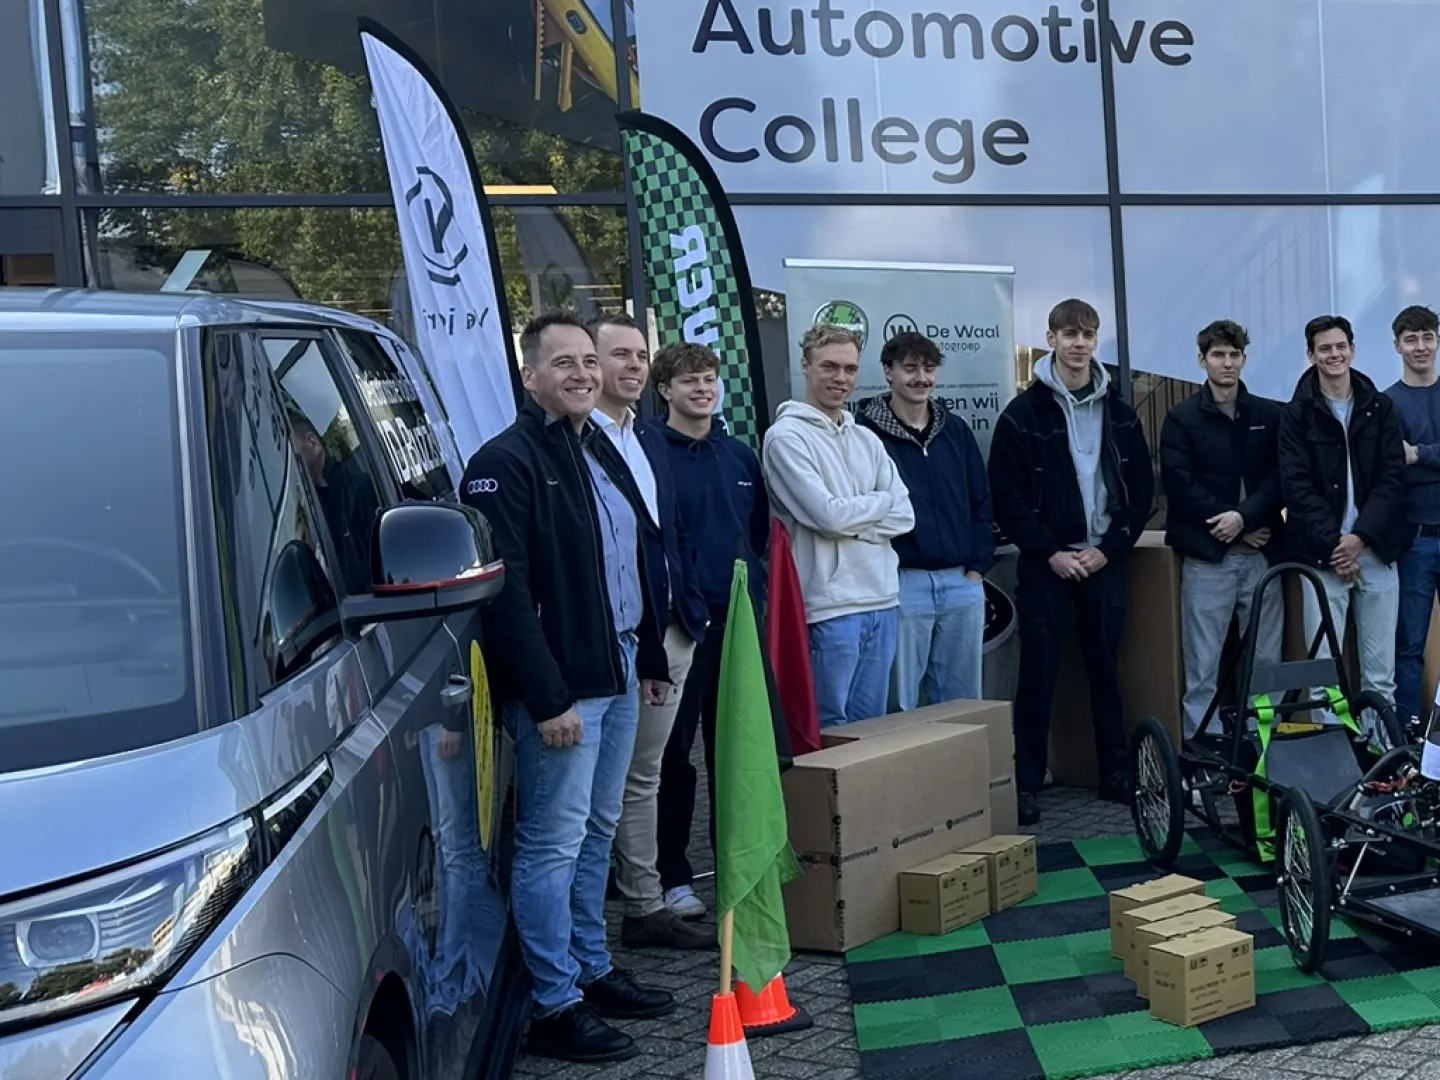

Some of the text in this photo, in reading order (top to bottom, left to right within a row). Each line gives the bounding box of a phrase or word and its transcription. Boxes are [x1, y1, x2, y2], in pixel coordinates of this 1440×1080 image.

[691, 0, 1195, 67] Automotive
[699, 96, 1030, 185] College
[926, 324, 1000, 338] De Waal
[938, 341, 981, 353] togroep
[971, 392, 999, 412] wij
[971, 414, 990, 430] in
